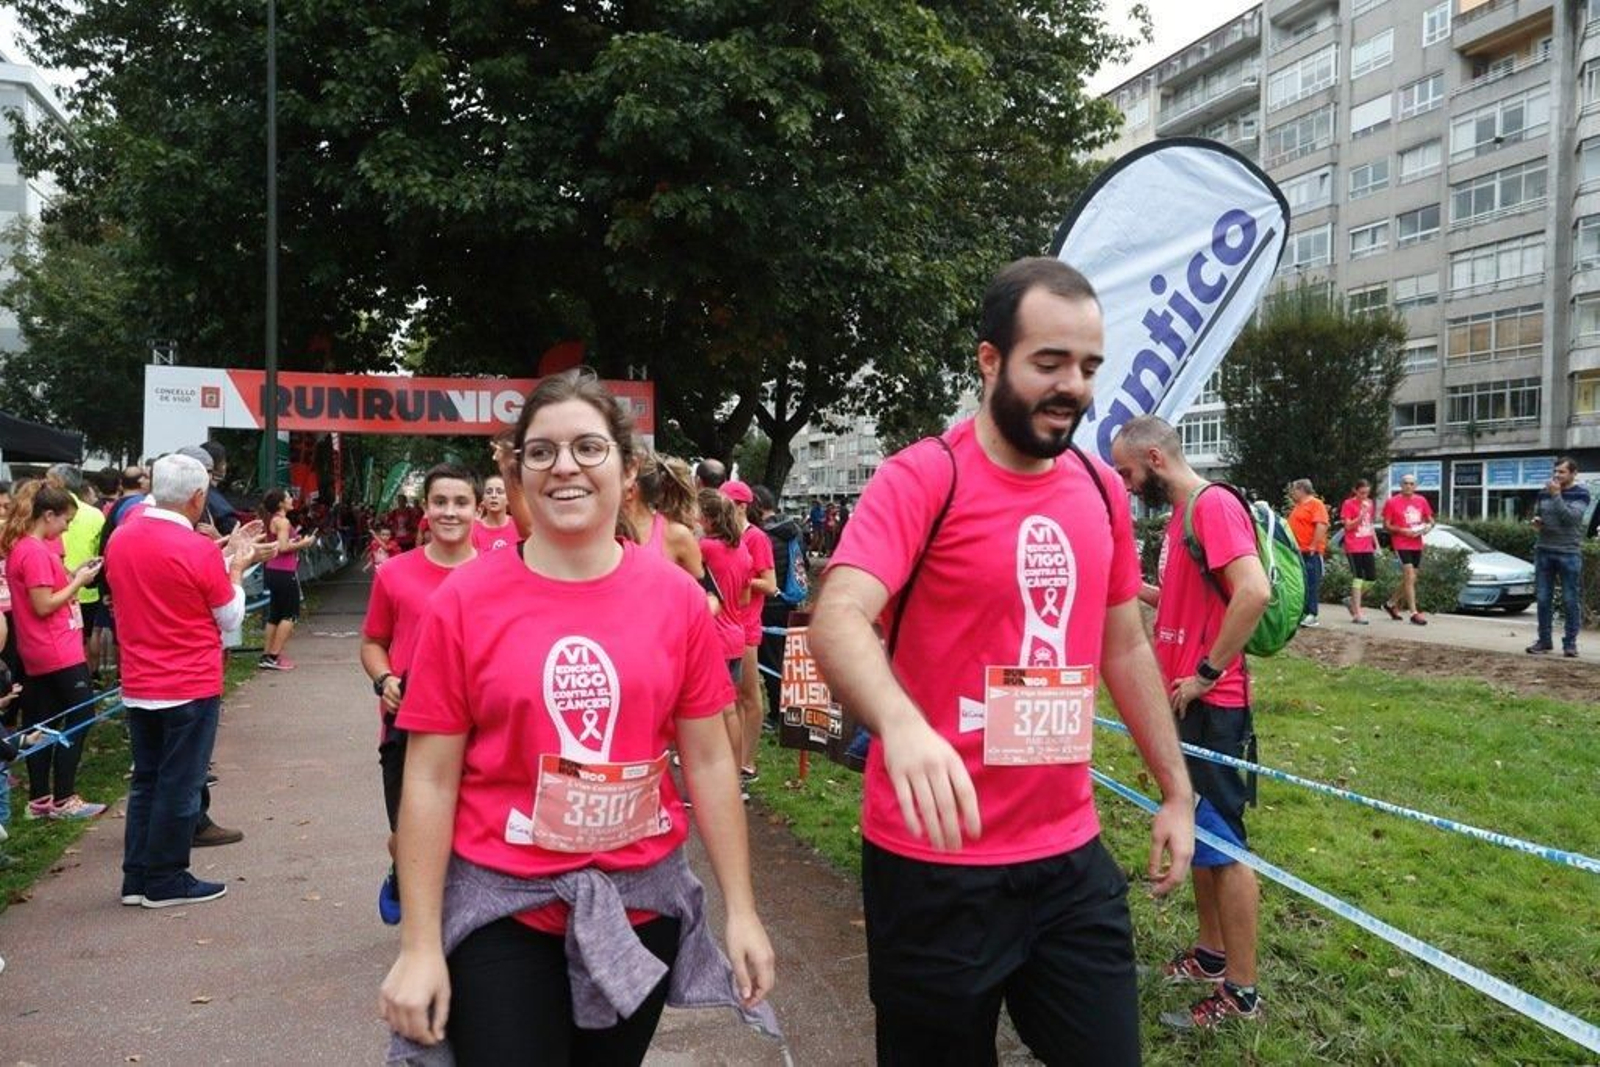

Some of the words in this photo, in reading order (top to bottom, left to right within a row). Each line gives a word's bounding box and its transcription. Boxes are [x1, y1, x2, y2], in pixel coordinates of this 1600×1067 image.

[154, 387, 196, 396] CONCELLO
[1030, 527, 1052, 543] VI
[1026, 553, 1066, 568] VIGO
[562, 646, 589, 664] VI
[783, 658, 818, 681] THE
[555, 673, 607, 690] VIGO
[553, 689, 596, 699] CONTRA
[1013, 699, 1082, 737] 3203
